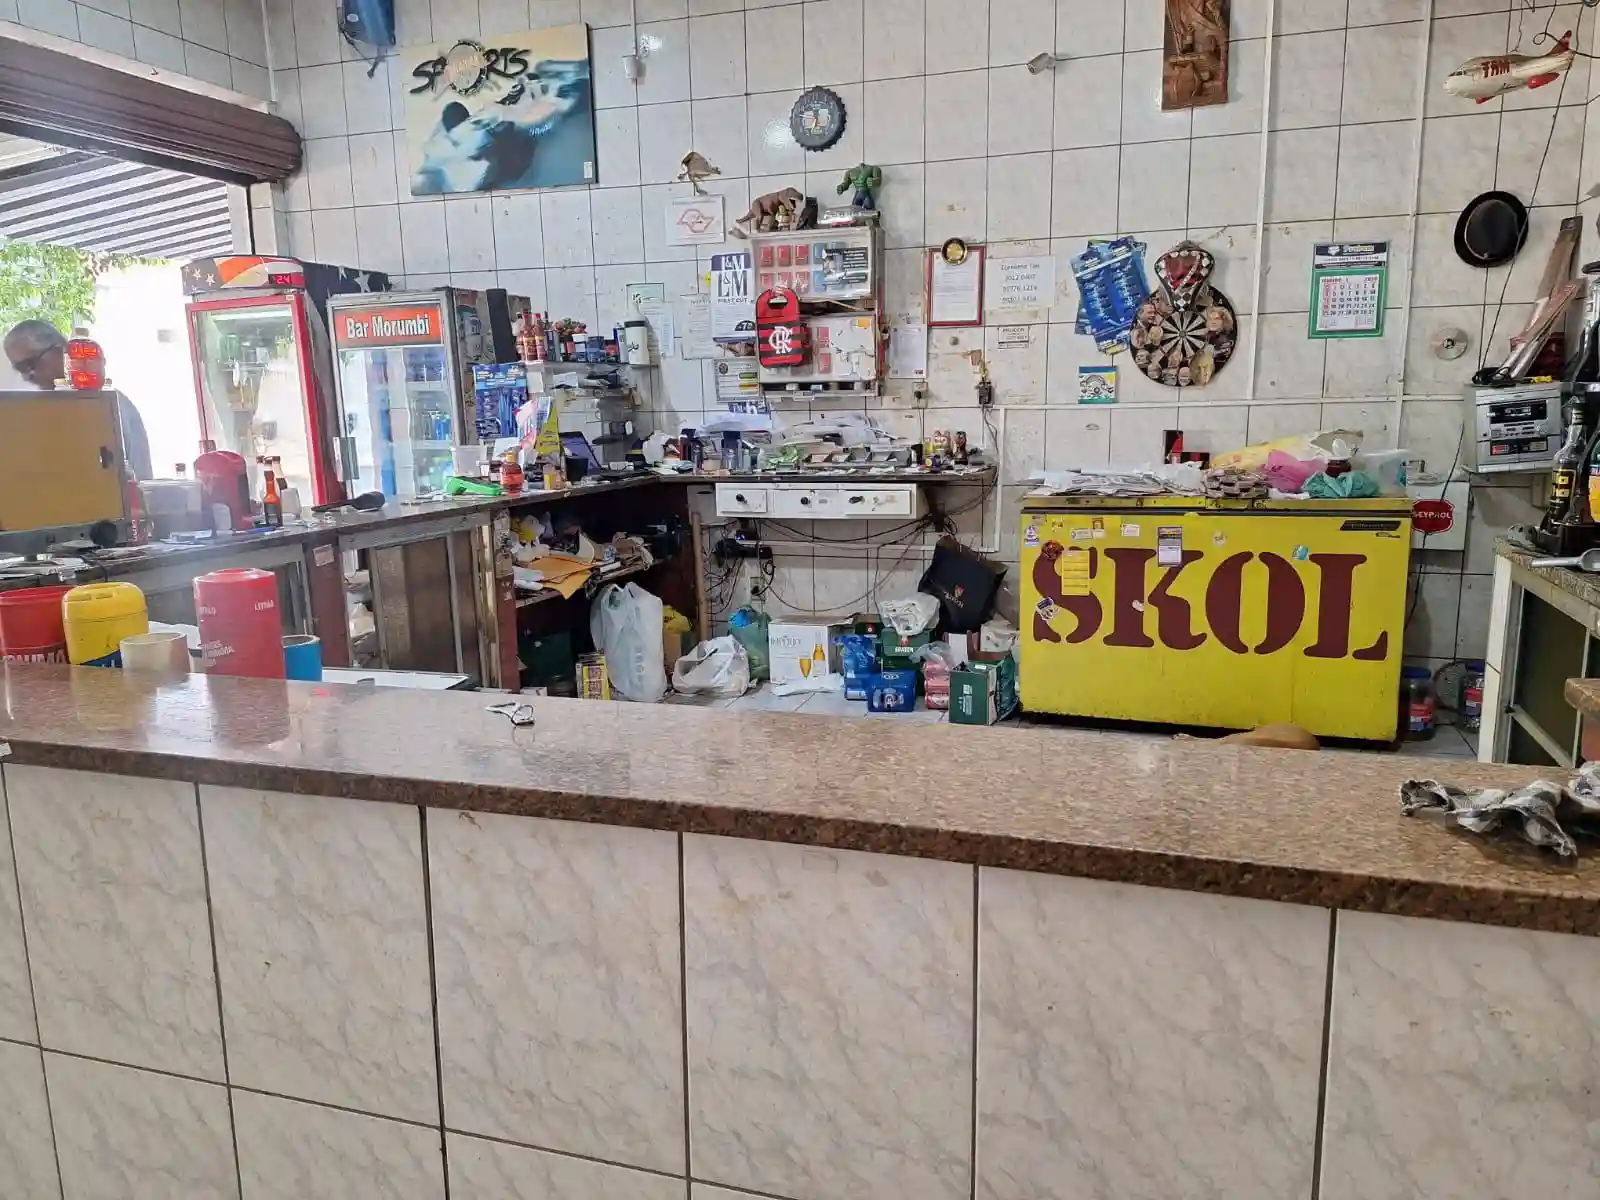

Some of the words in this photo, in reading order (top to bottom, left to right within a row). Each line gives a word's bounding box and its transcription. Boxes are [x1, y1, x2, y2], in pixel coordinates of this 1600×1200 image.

[1481, 60, 1510, 78] TAM
[346, 319, 368, 338] Bar
[372, 314, 430, 337] Morumbi
[1032, 546, 1388, 661] SKOL
